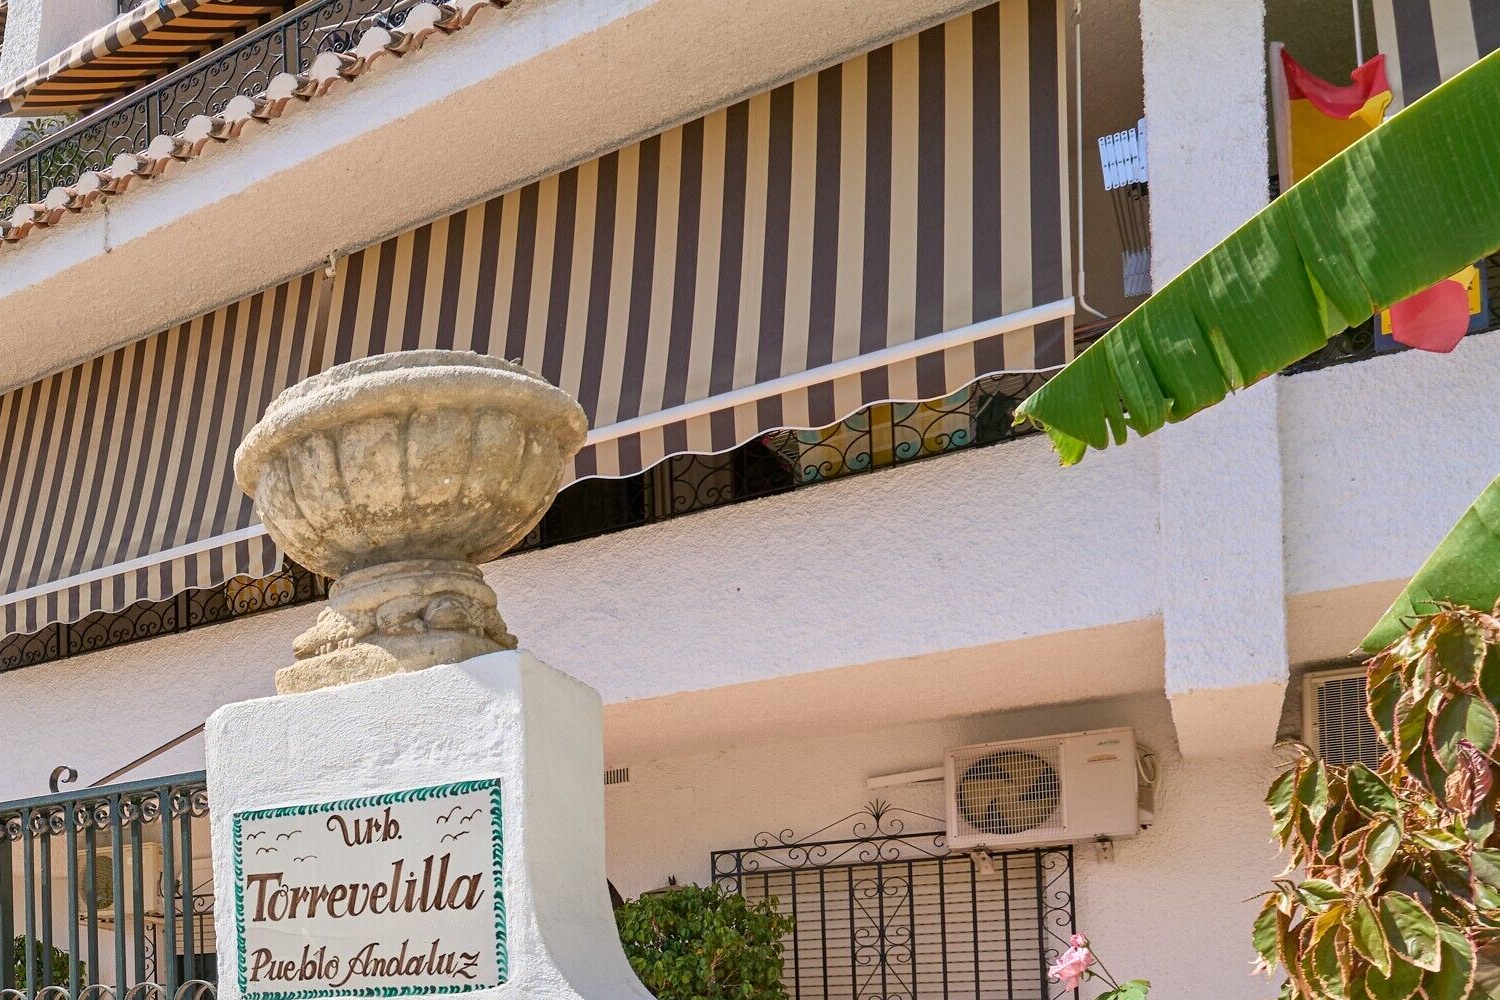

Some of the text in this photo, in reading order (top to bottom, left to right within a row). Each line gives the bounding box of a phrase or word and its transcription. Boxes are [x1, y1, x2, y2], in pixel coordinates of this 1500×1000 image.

[326, 807, 402, 846] Urb.
[247, 853, 485, 922] Torrevelilla
[250, 939, 480, 987] Pueblo Andaluz
